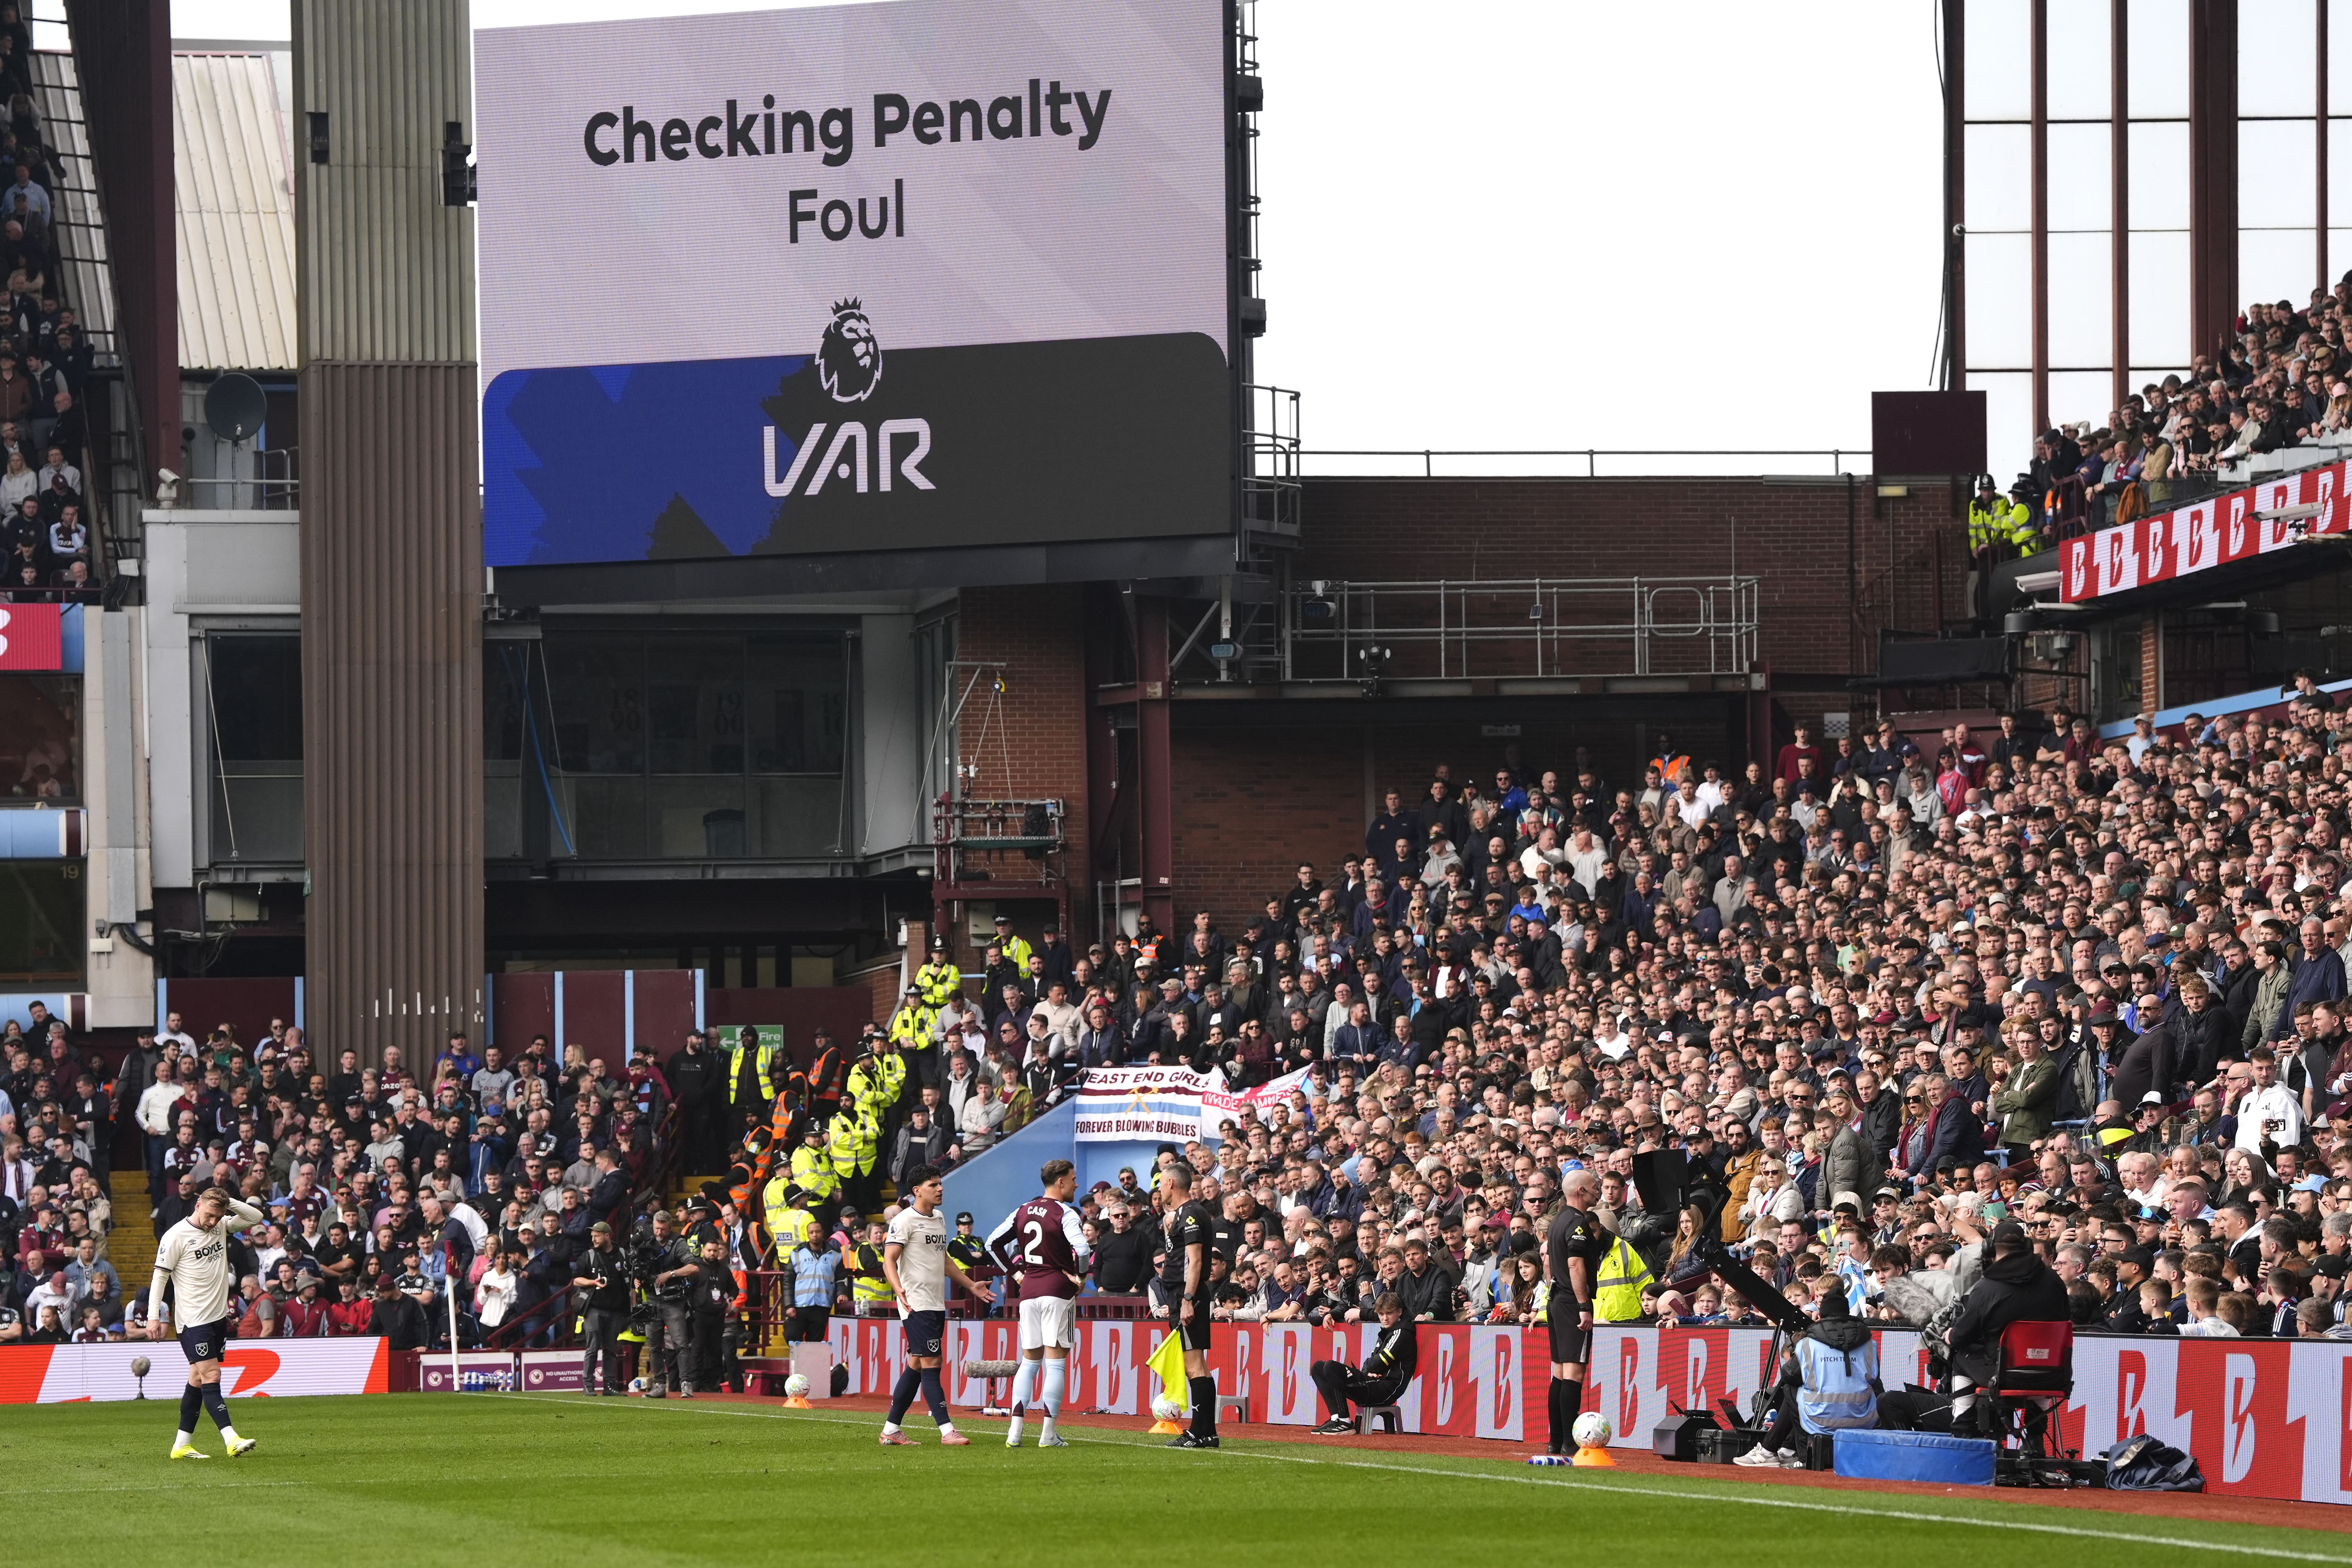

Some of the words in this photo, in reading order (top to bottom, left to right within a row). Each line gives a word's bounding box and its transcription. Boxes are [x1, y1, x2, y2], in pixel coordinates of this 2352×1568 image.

[584, 94, 853, 167] Checking
[875, 78, 1113, 151] Penalty
[788, 179, 904, 244] Foul
[762, 417, 936, 498] VAR
[60, 865, 79, 879] 19
[759, 1032, 781, 1041] Fire
[761, 1043, 780, 1051] xit
[1086, 1073, 1129, 1084] EAST
[1132, 1071, 1164, 1083] END
[1169, 1071, 1210, 1088] GIRLS
[1075, 1120, 1113, 1134] FOREVER
[1115, 1119, 1154, 1132] BLOWING
[1155, 1121, 1196, 1137] BUBBLES
[1027, 1206, 1048, 1218] CASH
[925, 1234, 946, 1244] BOYLE
[1024, 1221, 1043, 1264] 2
[194, 1241, 223, 1260] BOYLE
